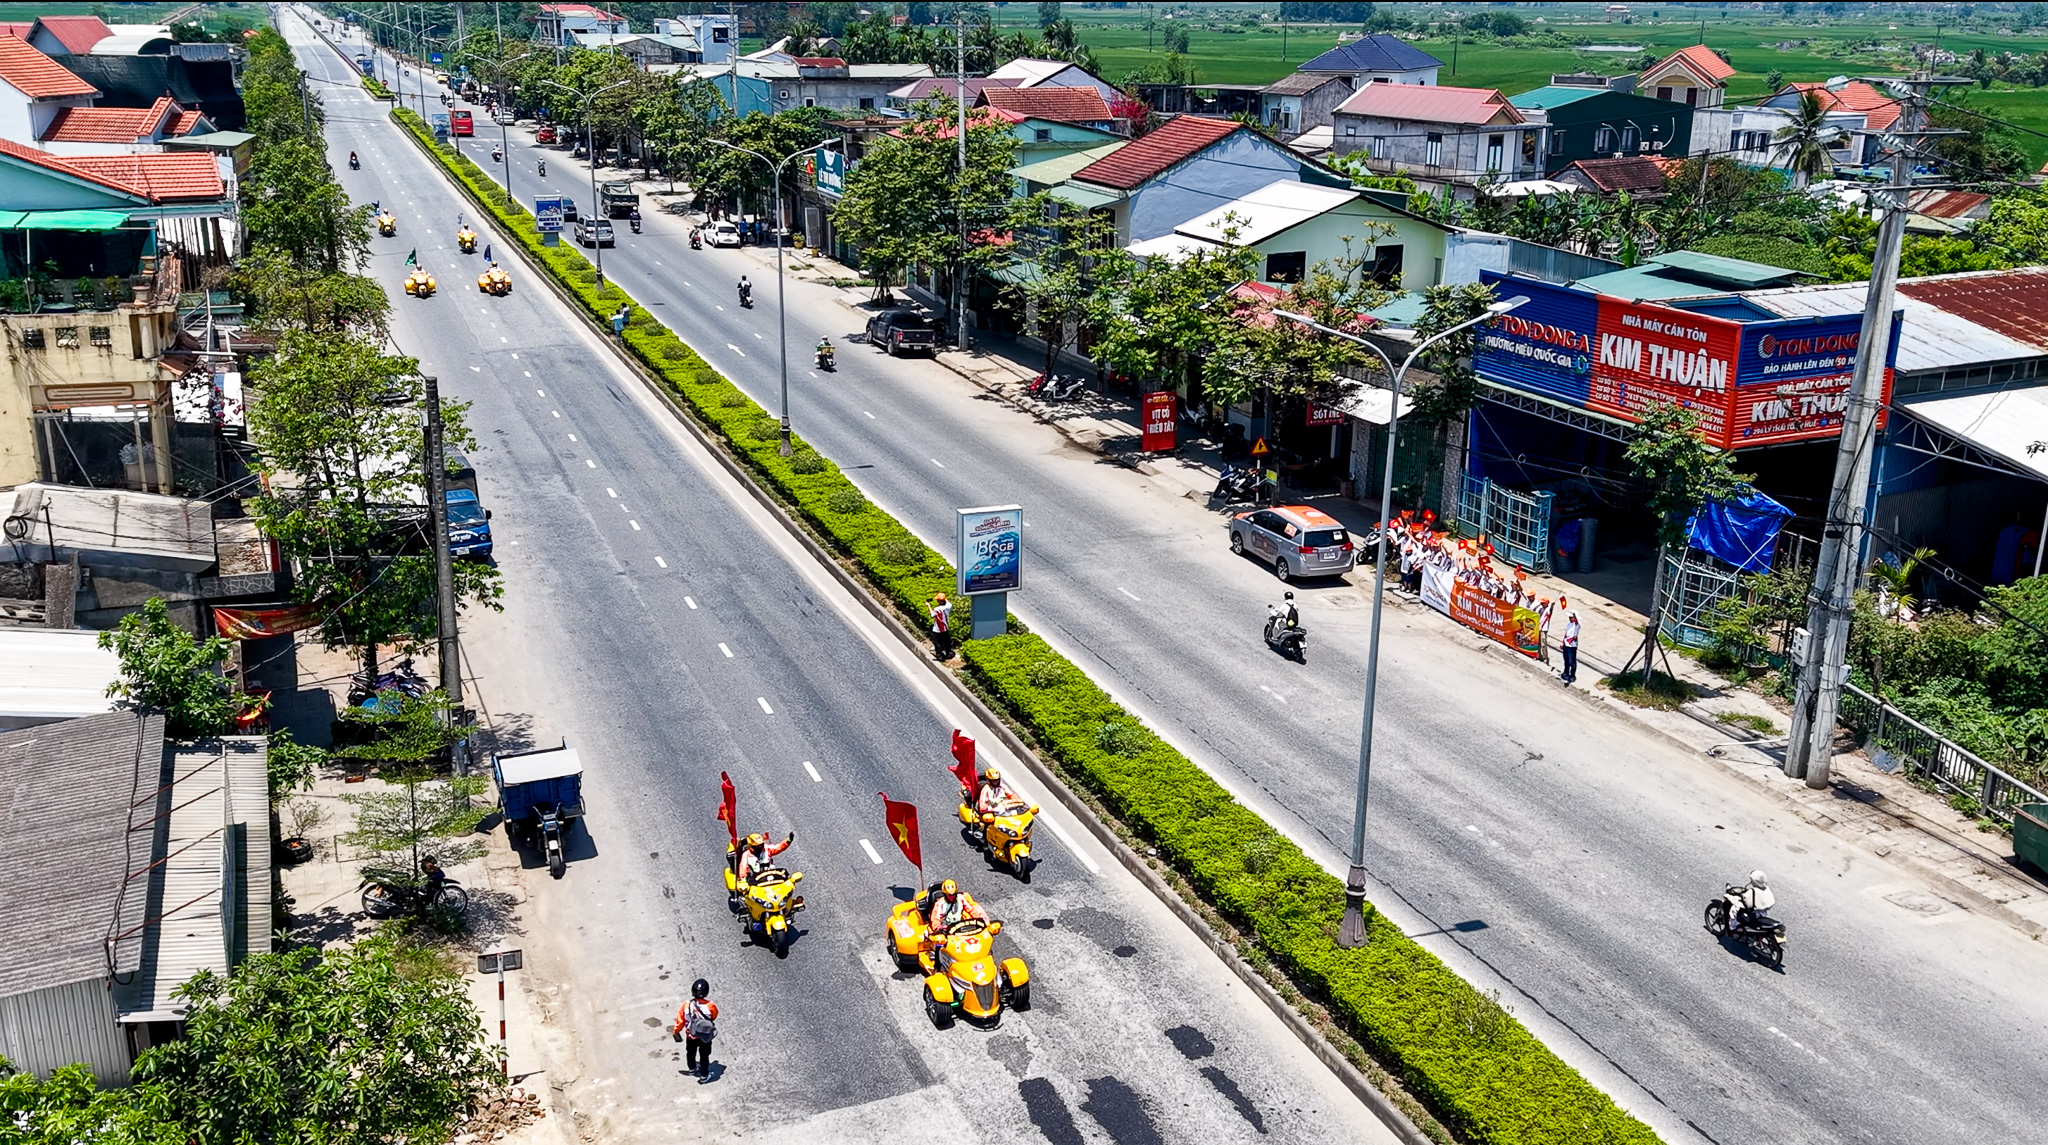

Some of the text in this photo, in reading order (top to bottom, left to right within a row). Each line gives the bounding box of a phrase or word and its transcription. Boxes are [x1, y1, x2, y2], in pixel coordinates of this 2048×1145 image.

[1532, 322, 1577, 349] DONG
[1578, 334, 1589, 353] A
[1622, 314, 1707, 342] NHÀ MÁY CÁN TÔN
[1485, 336, 1572, 368] THƯƠNG HIỆU QUỐC GIA
[1776, 337, 1812, 357] TON
[1600, 333, 1727, 397] KIM THUẬN
[1763, 362, 1779, 374] BẢO
[1781, 360, 1802, 372] HÀNH
[1803, 358, 1817, 369] LÊN
[1818, 357, 1834, 368] ĐẾN
[1777, 380, 1794, 393] NHÀ
[1795, 380, 1814, 391] MÁY
[1815, 377, 1834, 388] CÁN
[1751, 388, 1850, 422] KIM THUẬ
[999, 542, 1014, 551] GB
[1457, 594, 1472, 613] KIM
[1474, 603, 1504, 627] THUẬN
